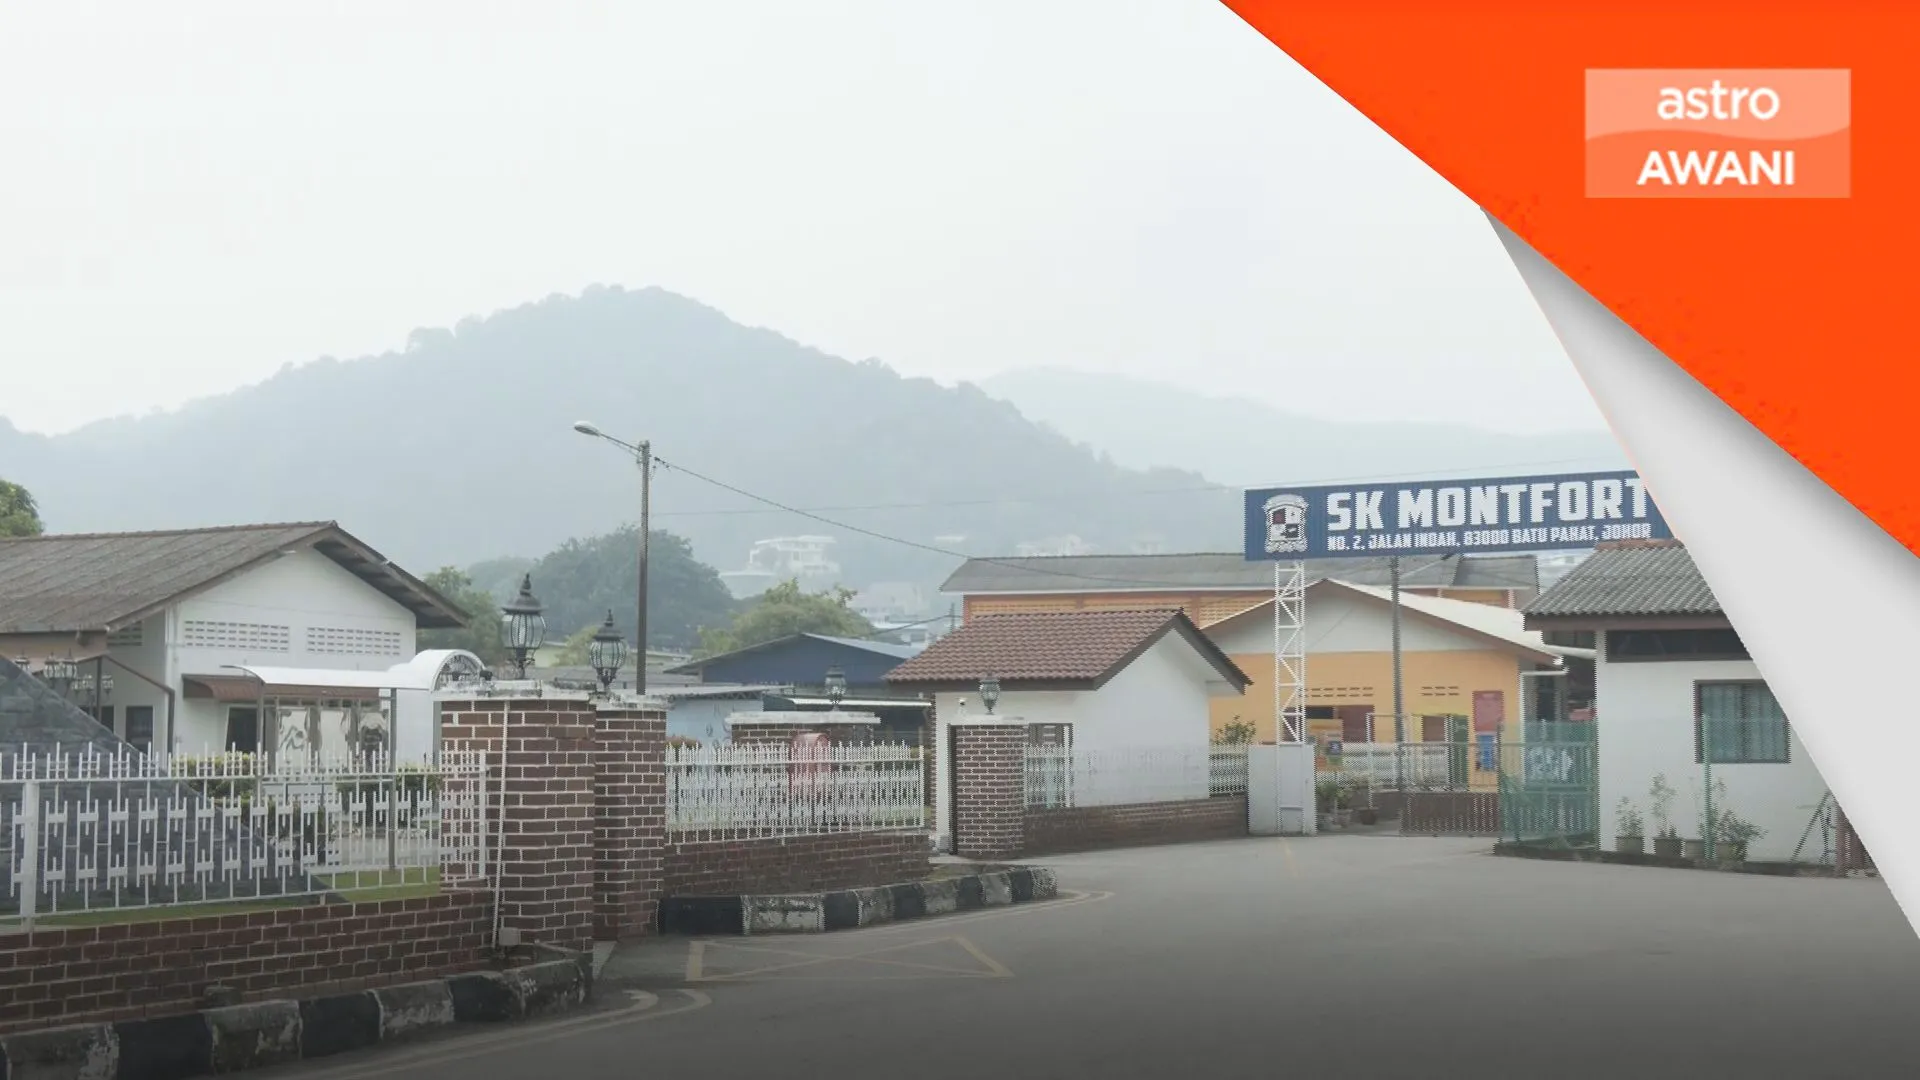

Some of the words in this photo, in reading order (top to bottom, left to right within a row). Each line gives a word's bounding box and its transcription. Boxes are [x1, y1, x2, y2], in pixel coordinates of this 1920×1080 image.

[1327, 491, 1385, 531] SK
[1398, 478, 1647, 528] MONTFORT
[1327, 535, 1350, 551] NO.
[1368, 533, 1412, 549] JALAN
[1464, 529, 1509, 545] 83000
[1511, 527, 1548, 543] BATU
[1602, 523, 1652, 540] JOHOR
